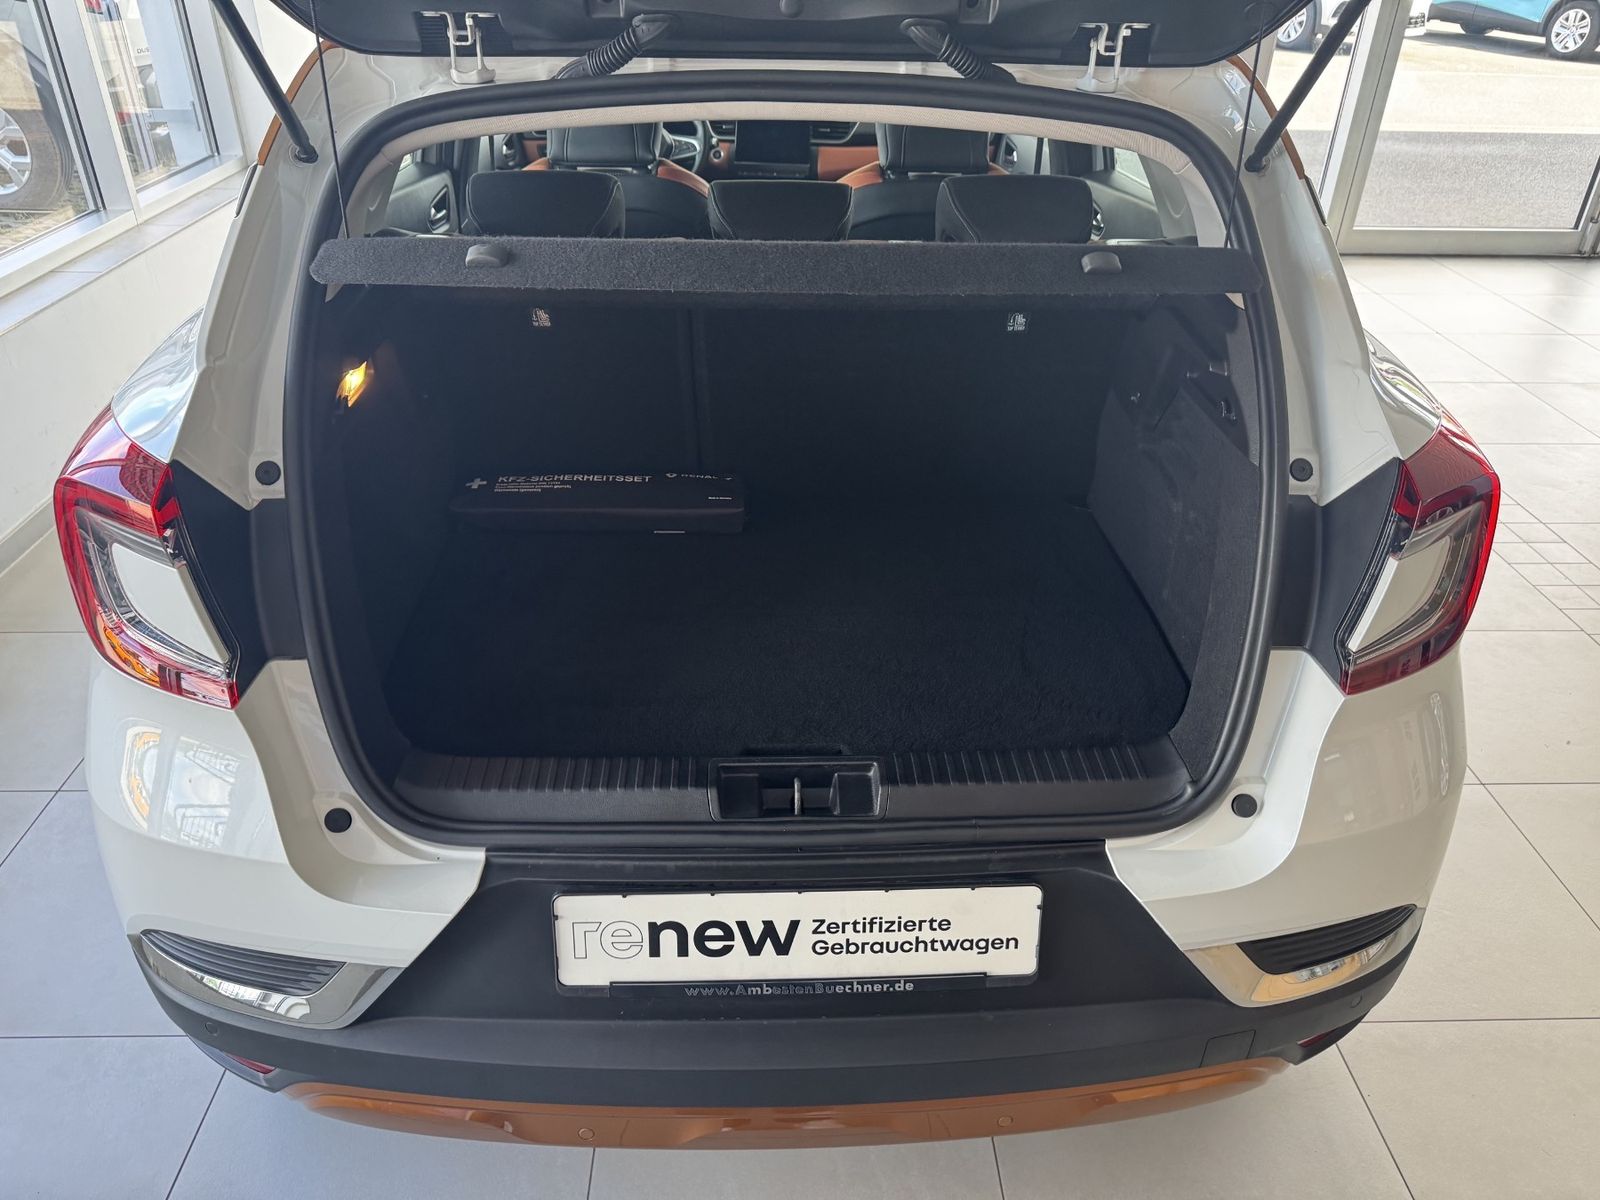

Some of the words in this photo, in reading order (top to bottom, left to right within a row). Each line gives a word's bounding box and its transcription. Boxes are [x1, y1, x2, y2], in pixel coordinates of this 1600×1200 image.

[497, 474, 652, 484] KFZ-SICHERHEITSSET
[811, 915, 952, 936] Zertifizierte
[571, 918, 801, 960] renew
[811, 935, 1019, 957] Gebrauchtwagen
[684, 979, 915, 997] www.AmbestenBuechner.de
